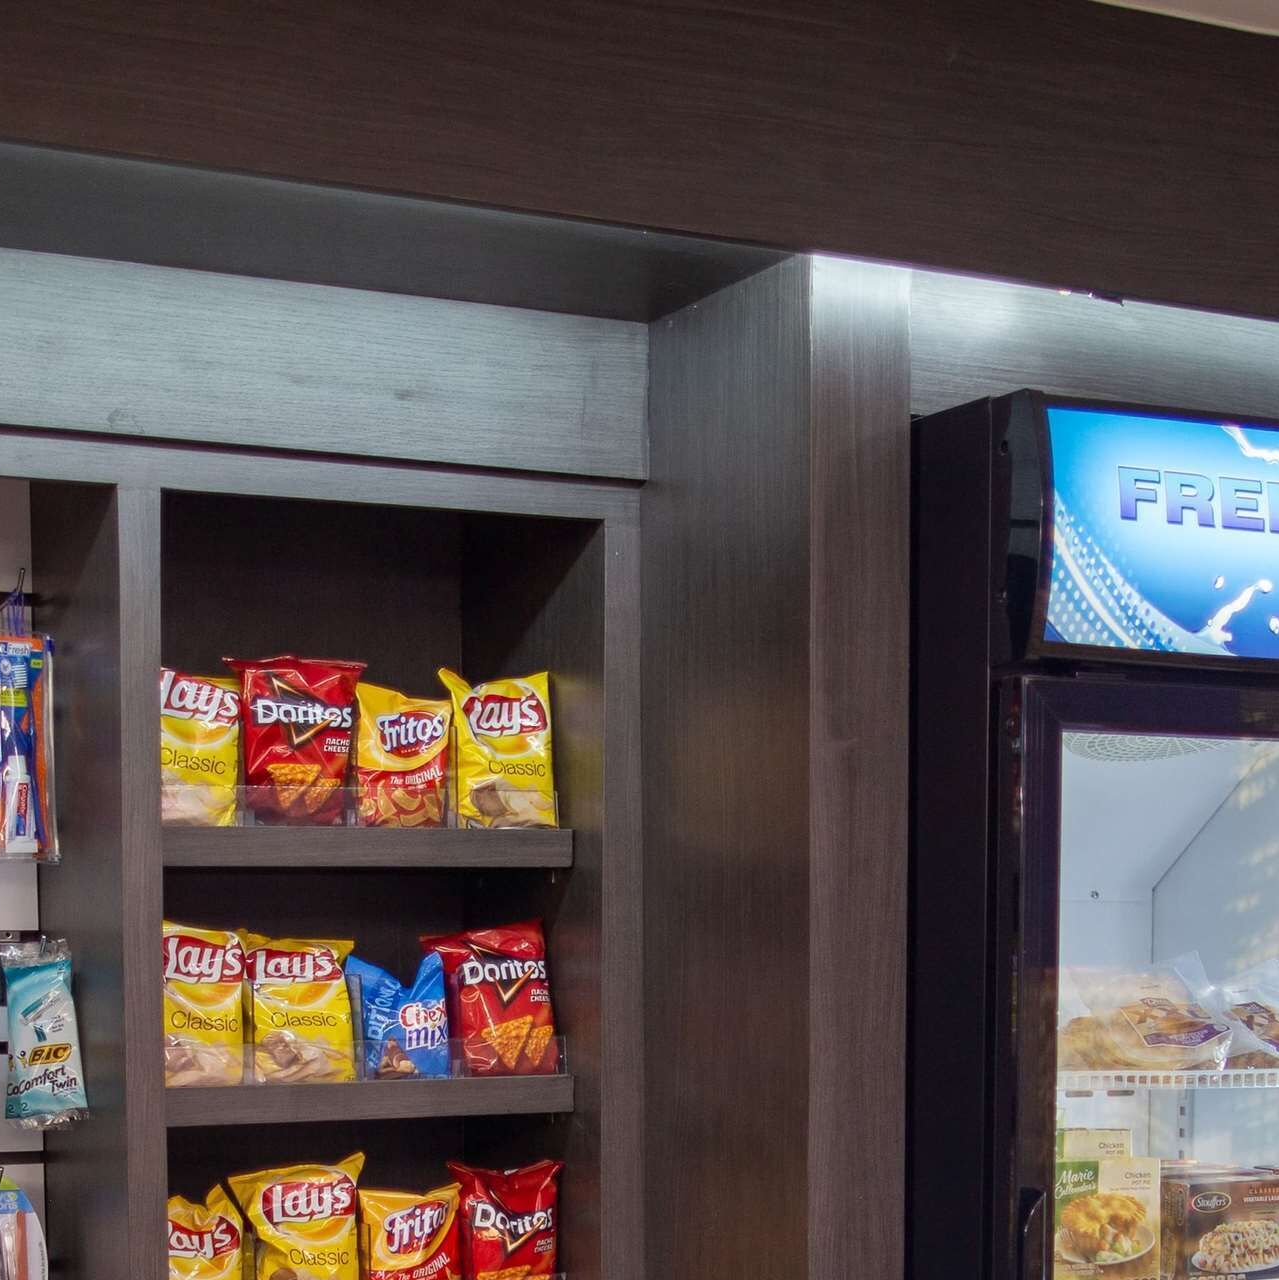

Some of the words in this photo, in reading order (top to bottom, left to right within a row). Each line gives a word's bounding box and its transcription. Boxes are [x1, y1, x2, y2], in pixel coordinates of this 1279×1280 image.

[7, 643, 31, 655] Fresh
[257, 699, 352, 729] Doritos
[376, 710, 445, 752] Fritos
[161, 748, 225, 775] Classic
[489, 759, 546, 778] Classic
[390, 776, 404, 785] The
[405, 766, 443, 787] ORIGINAL
[166, 937, 243, 985] Lay's
[256, 946, 333, 985] Lay's
[464, 958, 546, 986] Doritos
[171, 1010, 239, 1034] Classic
[271, 1011, 338, 1029] Classic
[400, 999, 447, 1029] Chex
[407, 1024, 448, 1050] mix
[32, 1045, 68, 1063] BIC
[20, 1065, 66, 1097] Comfort
[50, 1077, 77, 1092] Twin
[1056, 1169, 1095, 1187] Marie
[272, 1177, 352, 1224] Lay's
[384, 1201, 447, 1253] Fritos
[473, 1200, 553, 1237] Doritos
[289, 1248, 349, 1267] Classic
[412, 1255, 451, 1279] ORIGINAL
